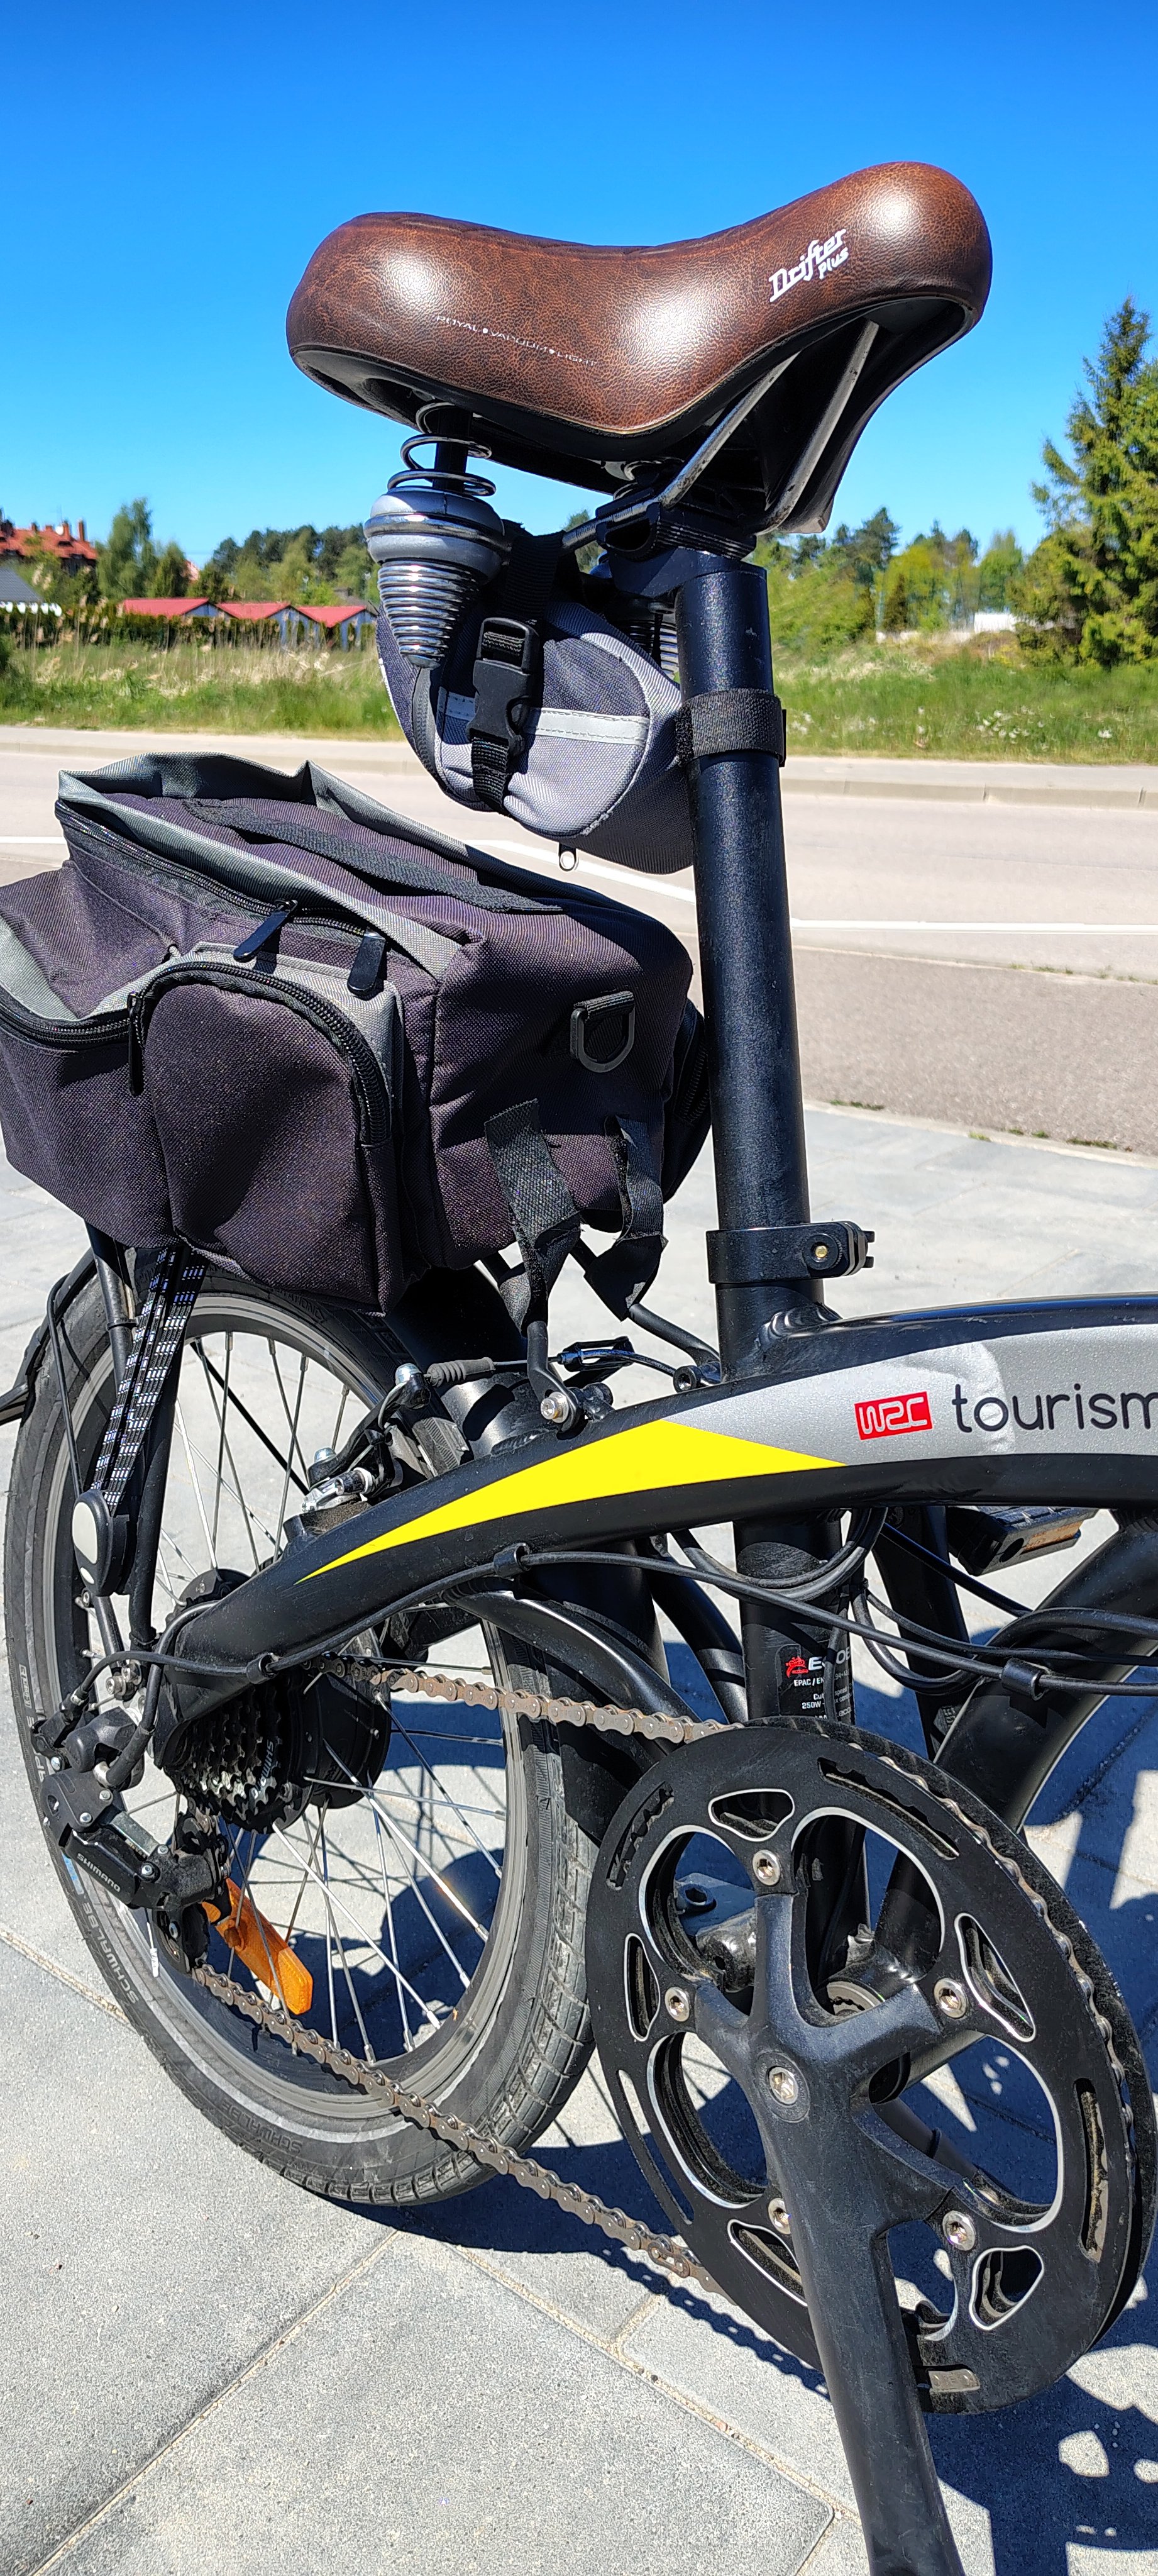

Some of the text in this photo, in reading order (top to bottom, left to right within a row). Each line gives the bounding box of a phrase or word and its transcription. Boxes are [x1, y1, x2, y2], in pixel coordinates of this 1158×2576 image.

[768, 228, 847, 303] Drifter
[793, 1679, 812, 1687] EPAC
[802, 1701, 822, 1709] 250W
[77, 1853, 121, 1892] SHIMANO
[82, 1901, 139, 2004] SCHWALBE
[221, 2100, 303, 2154] SCHWALBE
